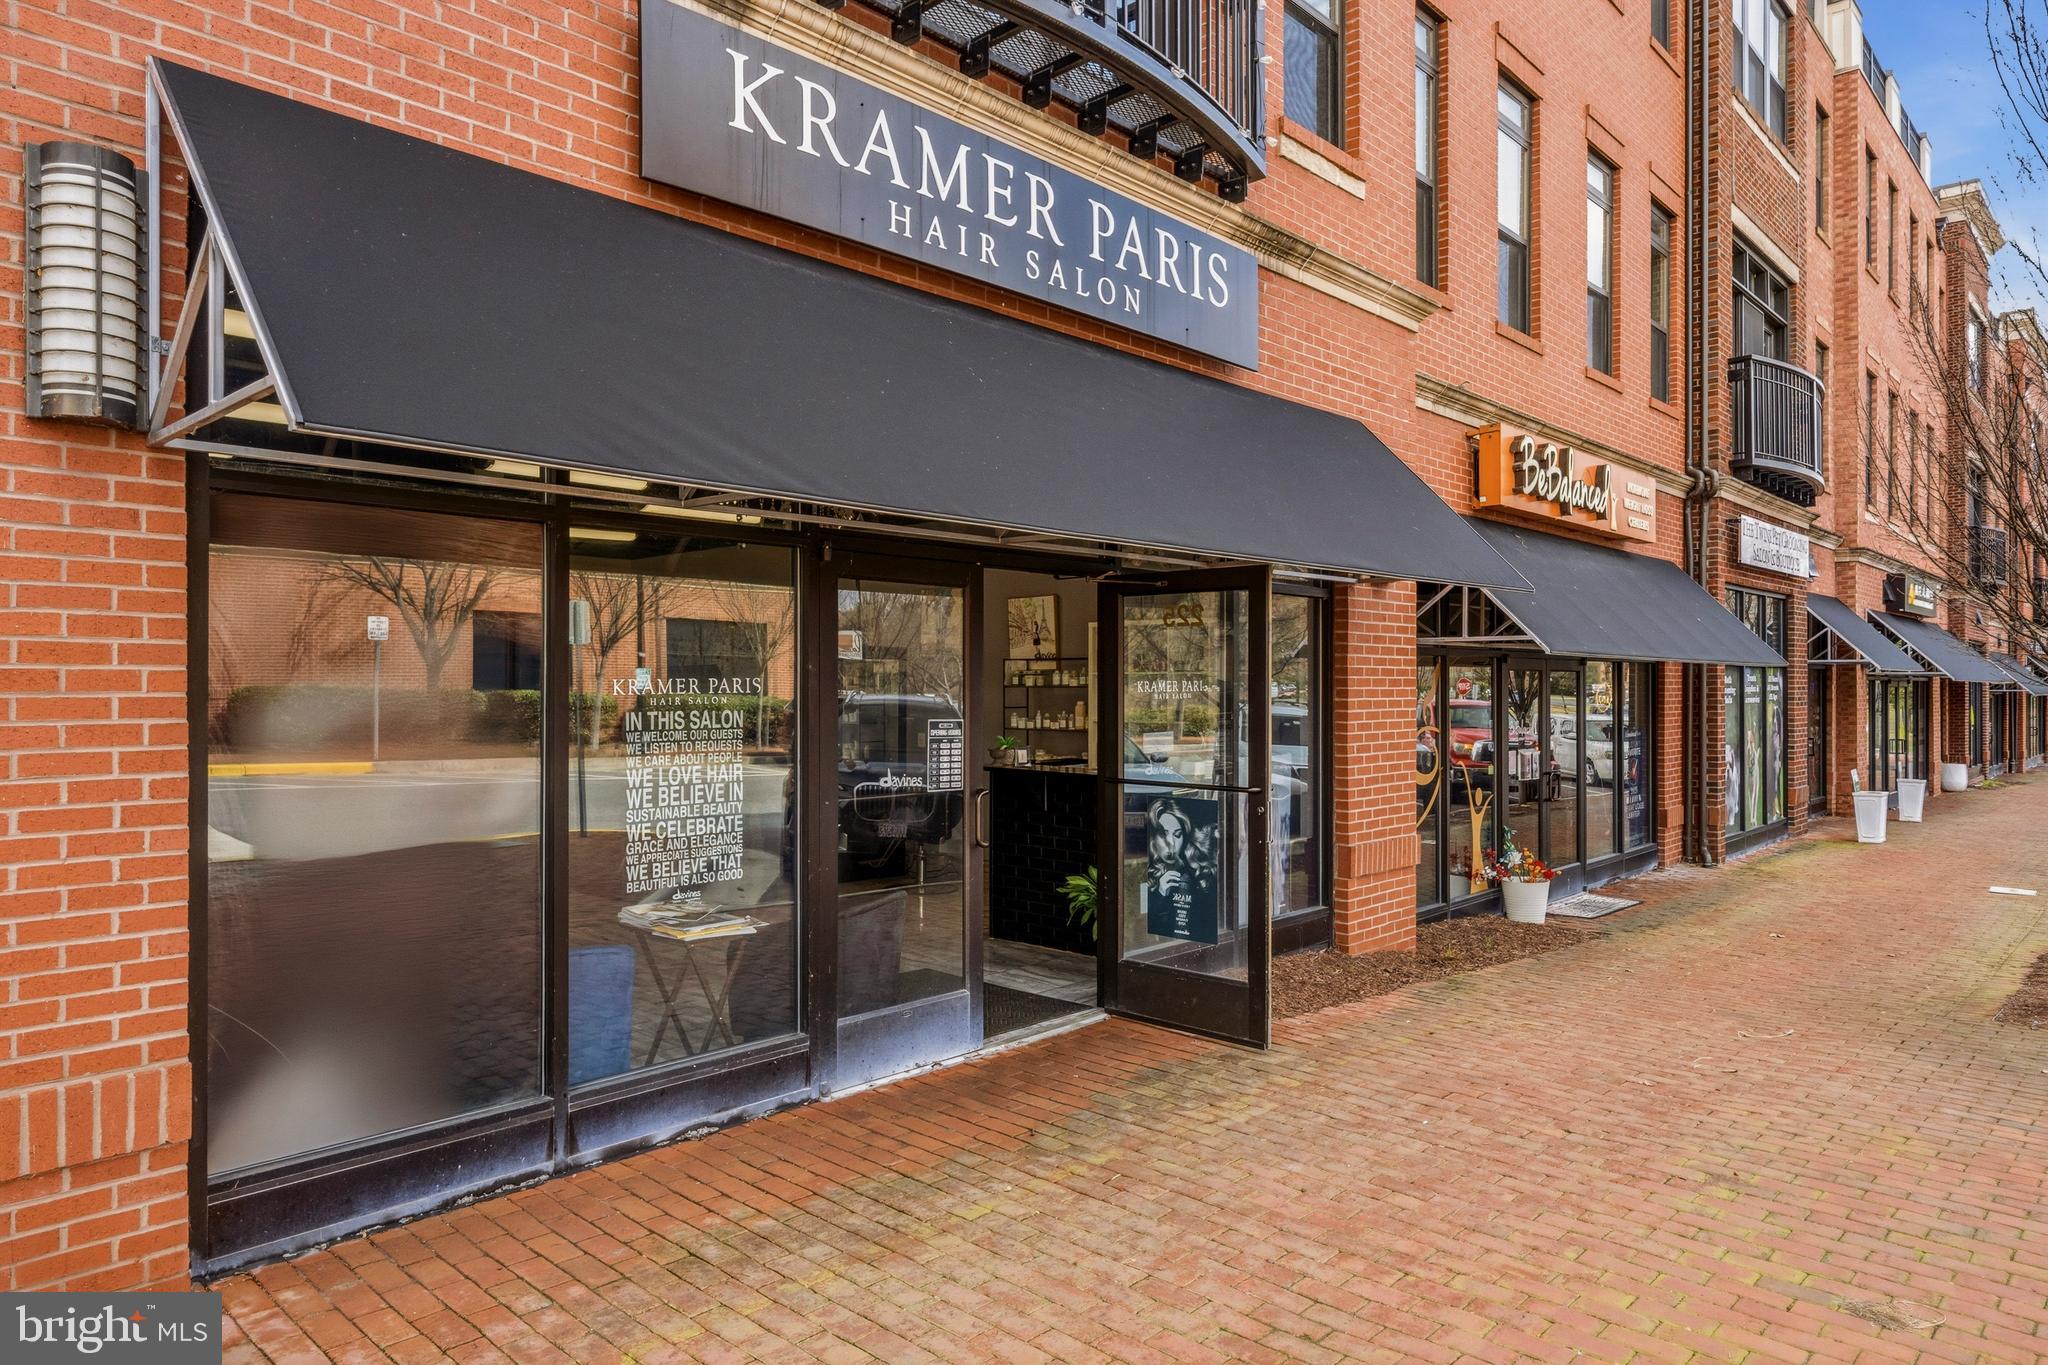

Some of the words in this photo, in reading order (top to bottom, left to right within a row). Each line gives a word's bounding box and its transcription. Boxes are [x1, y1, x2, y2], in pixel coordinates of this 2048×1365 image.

[726, 48, 1064, 246] KRAMER
[1087, 197, 1229, 308] PARIS
[888, 199, 1000, 268] HAIR
[1025, 250, 1141, 315] SALON
[1517, 434, 1612, 516] BeBalanced
[612, 677, 701, 696] KRAMER
[708, 677, 762, 694] PARIS
[1137, 680, 1179, 693] KRAMER
[650, 697, 681, 706] HAIR
[688, 696, 728, 705] SALON
[625, 711, 642, 731] IN
[647, 710, 685, 730] THIS
[689, 709, 744, 730] SALON
[626, 731, 641, 743] WE
[642, 730, 688, 742] WELCOME
[690, 729, 708, 741] OUR
[710, 728, 743, 740] GUESTS
[626, 743, 642, 755] WE
[644, 742, 678, 754] LISTEN
[680, 741, 693, 753] TO
[695, 740, 743, 752] REQUESTS
[626, 756, 642, 769] WE
[644, 754, 672, 767] CARE
[673, 753, 706, 765] ABOUT
[707, 751, 743, 764] PEOPLE
[626, 768, 654, 788] WE
[658, 765, 702, 786] LOVE
[706, 763, 743, 783] HAIR
[879, 767, 923, 790] davines
[626, 788, 653, 809] WE
[658, 783, 725, 807] BELIEVE
[729, 782, 744, 801] IN
[626, 804, 701, 823] SUSTAINABLE
[702, 801, 743, 815] BEAUTY
[626, 822, 652, 842] WE
[656, 814, 743, 839] CELEBRATE
[626, 839, 664, 856] GRACE
[666, 837, 688, 851] AND
[690, 832, 743, 848] ELEGANCE
[626, 855, 639, 866] WE
[640, 849, 690, 864] APPRECIATE
[690, 844, 743, 859] SUGGESTIONS
[626, 864, 648, 881] WE
[652, 858, 707, 878] BELIEVE
[710, 853, 743, 871] THAT
[626, 876, 679, 894] BEAUTIFUL
[680, 875, 690, 887] IS
[691, 871, 716, 885] ALSO
[717, 868, 743, 881] GOOD
